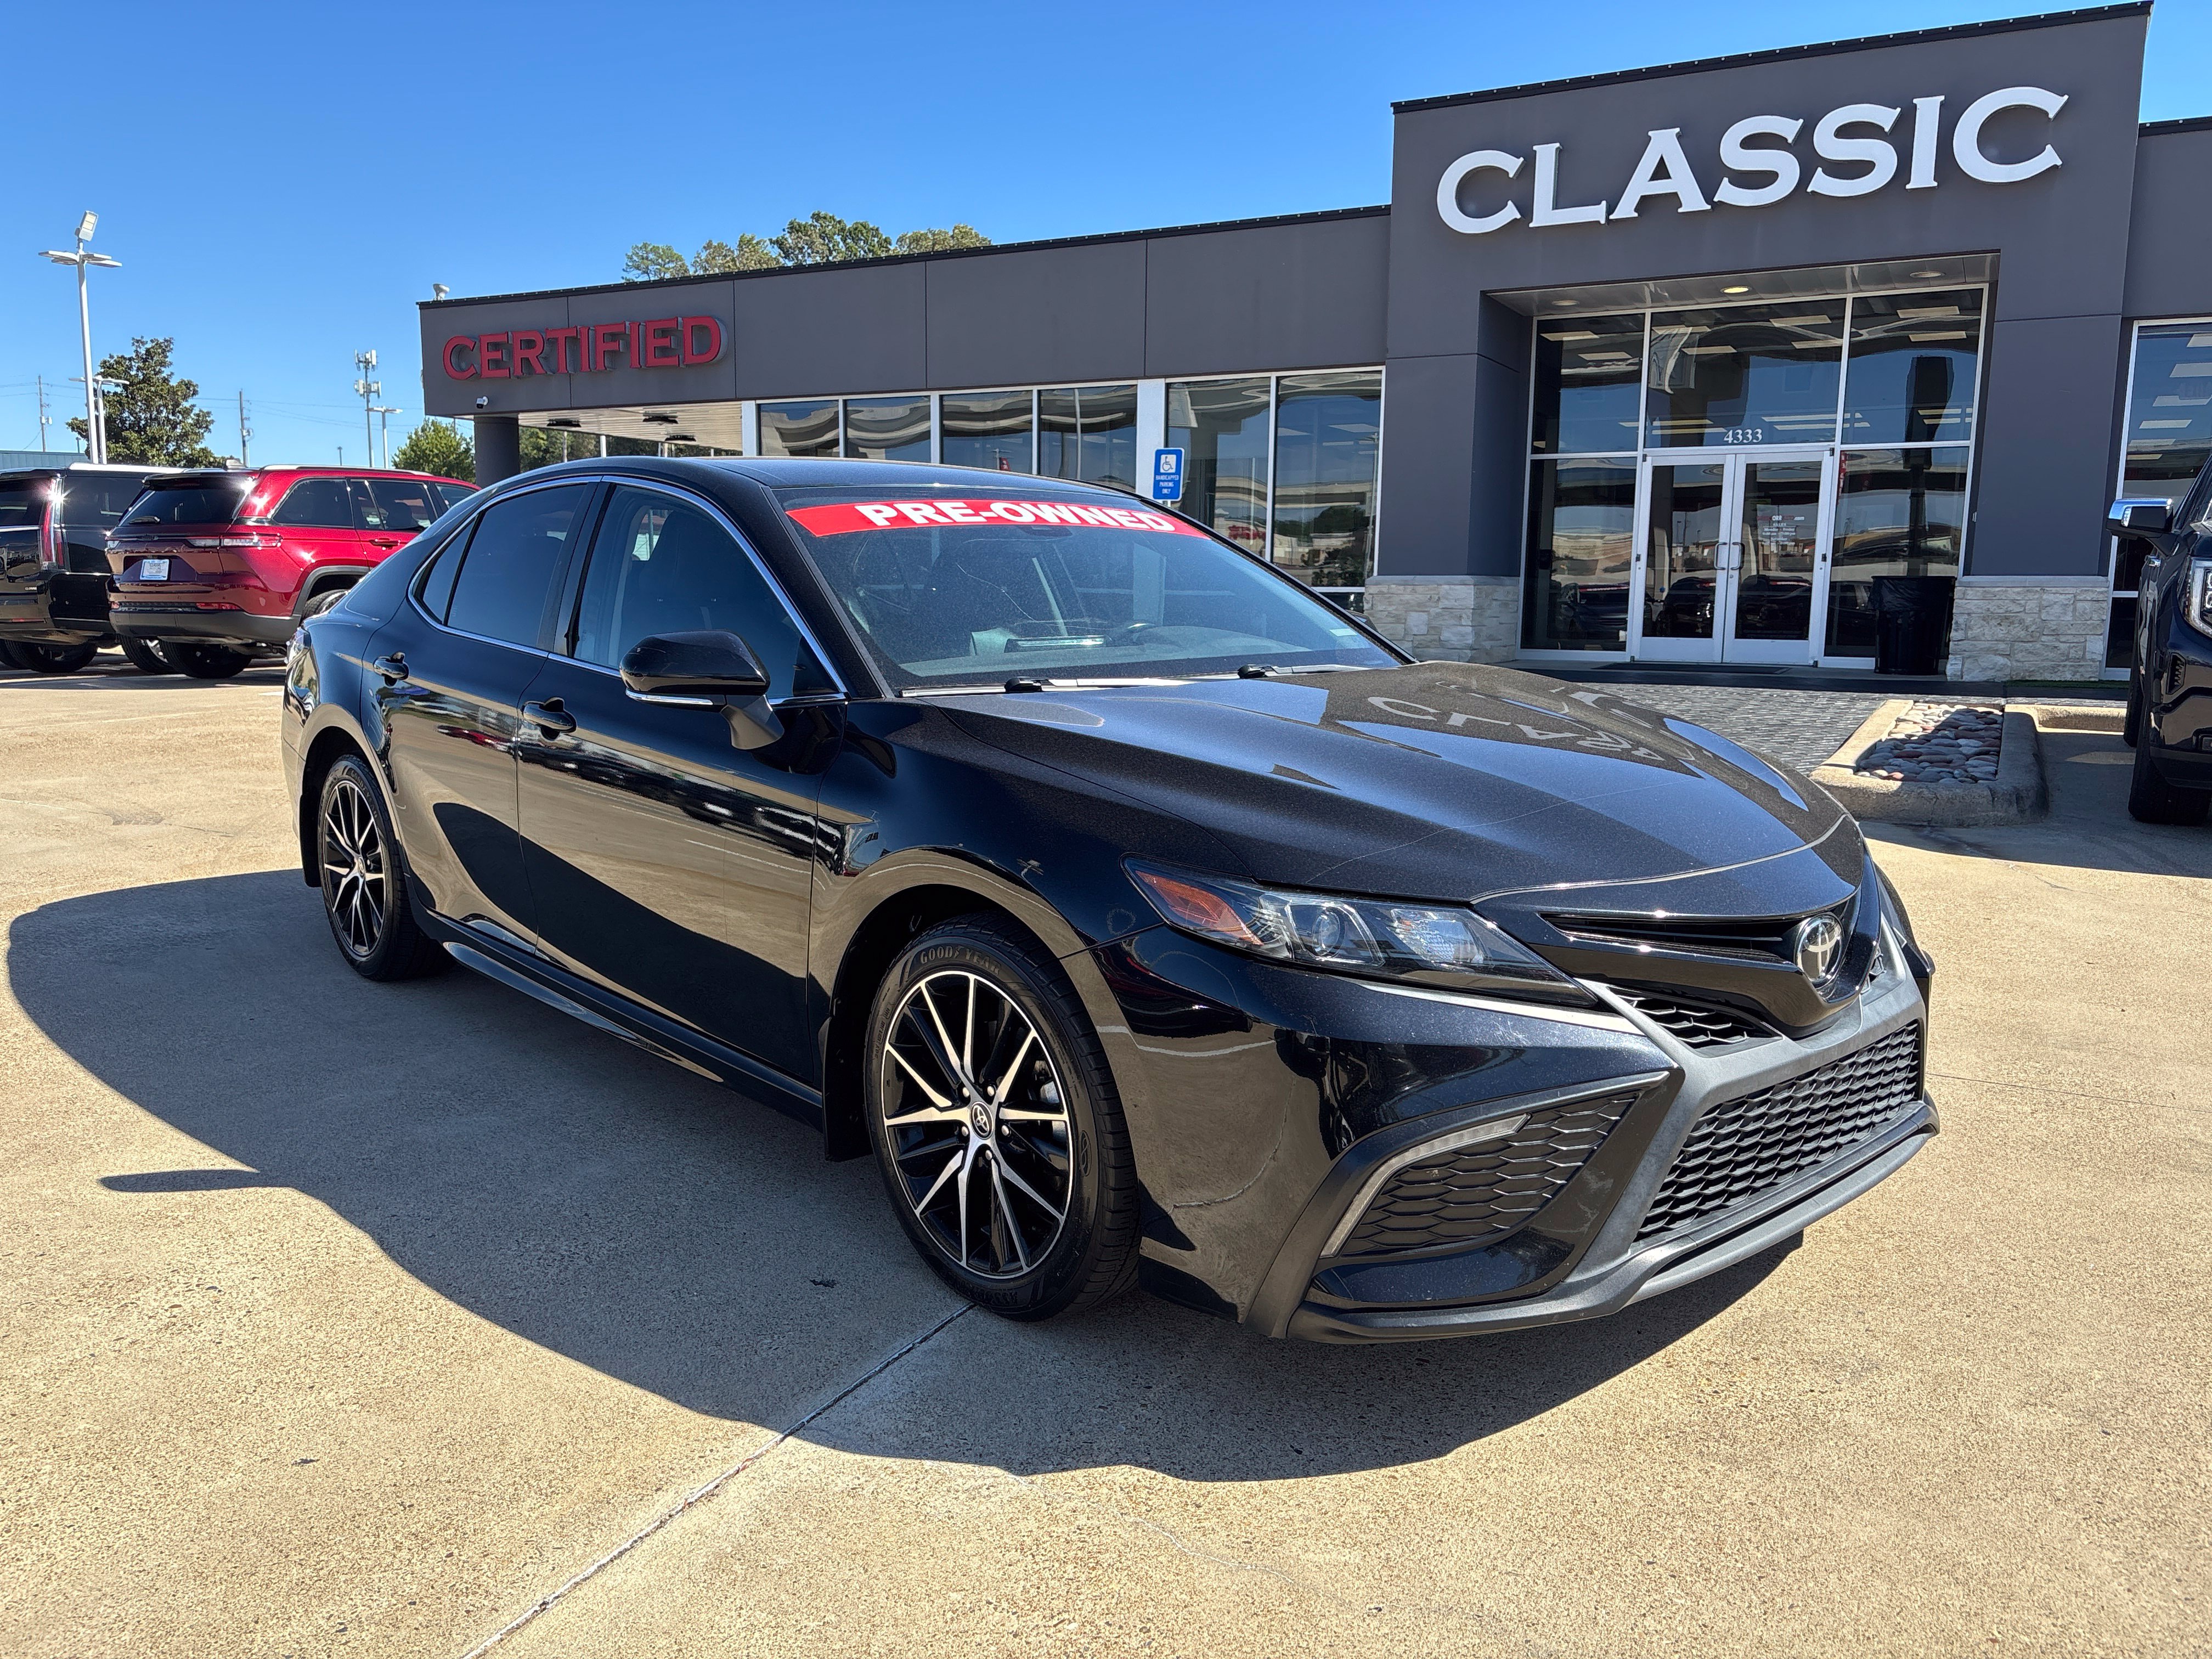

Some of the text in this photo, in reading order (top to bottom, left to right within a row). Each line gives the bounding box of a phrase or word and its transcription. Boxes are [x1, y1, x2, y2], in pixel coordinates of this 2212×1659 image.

[1436, 86, 2070, 234] CLASSIC
[442, 315, 725, 381] CERTIFIED
[1723, 428, 1763, 444] 4333
[854, 500, 1176, 532] PRE-OWNED
